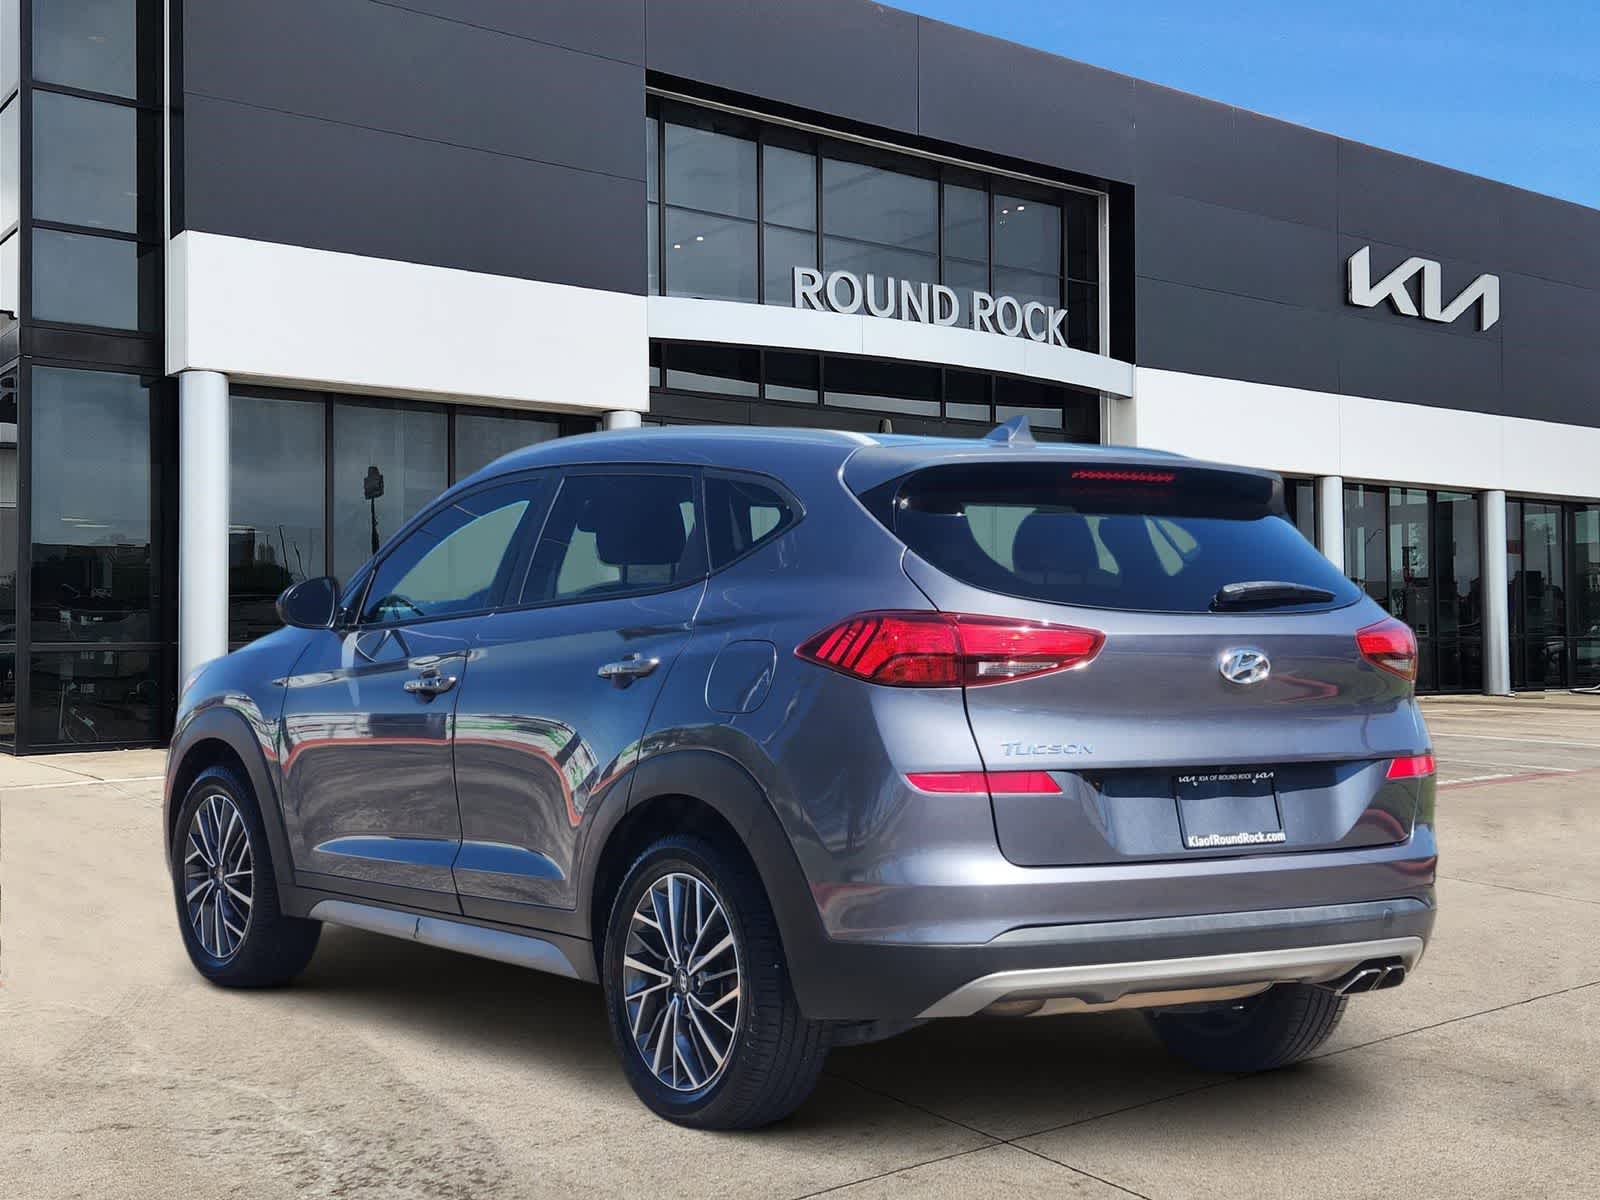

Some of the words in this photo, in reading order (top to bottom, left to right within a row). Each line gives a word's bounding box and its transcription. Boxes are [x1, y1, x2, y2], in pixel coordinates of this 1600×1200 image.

[793, 266, 960, 326] ROUND
[971, 290, 1069, 347] ROCK
[1348, 245, 1500, 332] KIA
[1000, 741, 1094, 757] TUCSON
[1187, 831, 1286, 847] KiaofRoundRock.com
